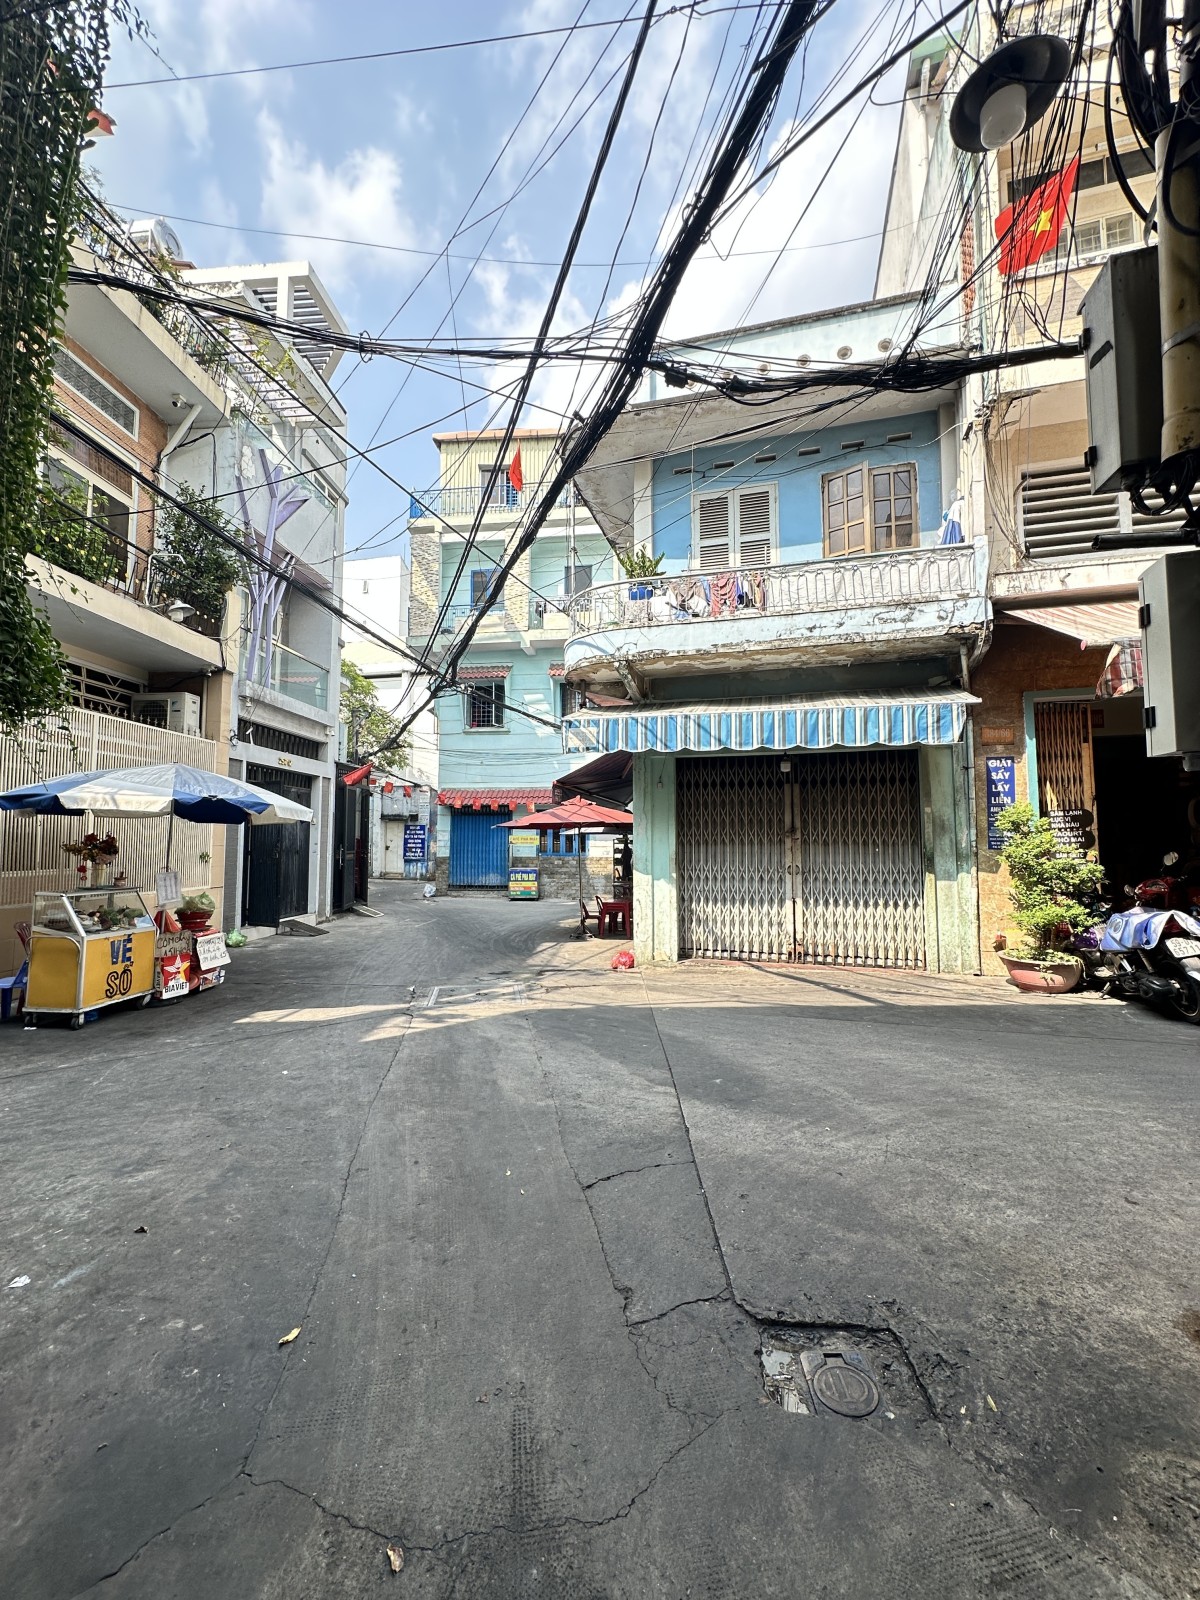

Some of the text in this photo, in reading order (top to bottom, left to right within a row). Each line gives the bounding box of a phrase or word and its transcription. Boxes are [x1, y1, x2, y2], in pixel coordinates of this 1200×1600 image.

[991, 769, 1010, 780] SẤY
[992, 781, 1010, 792] LẤY
[105, 961, 134, 999] SỐ
